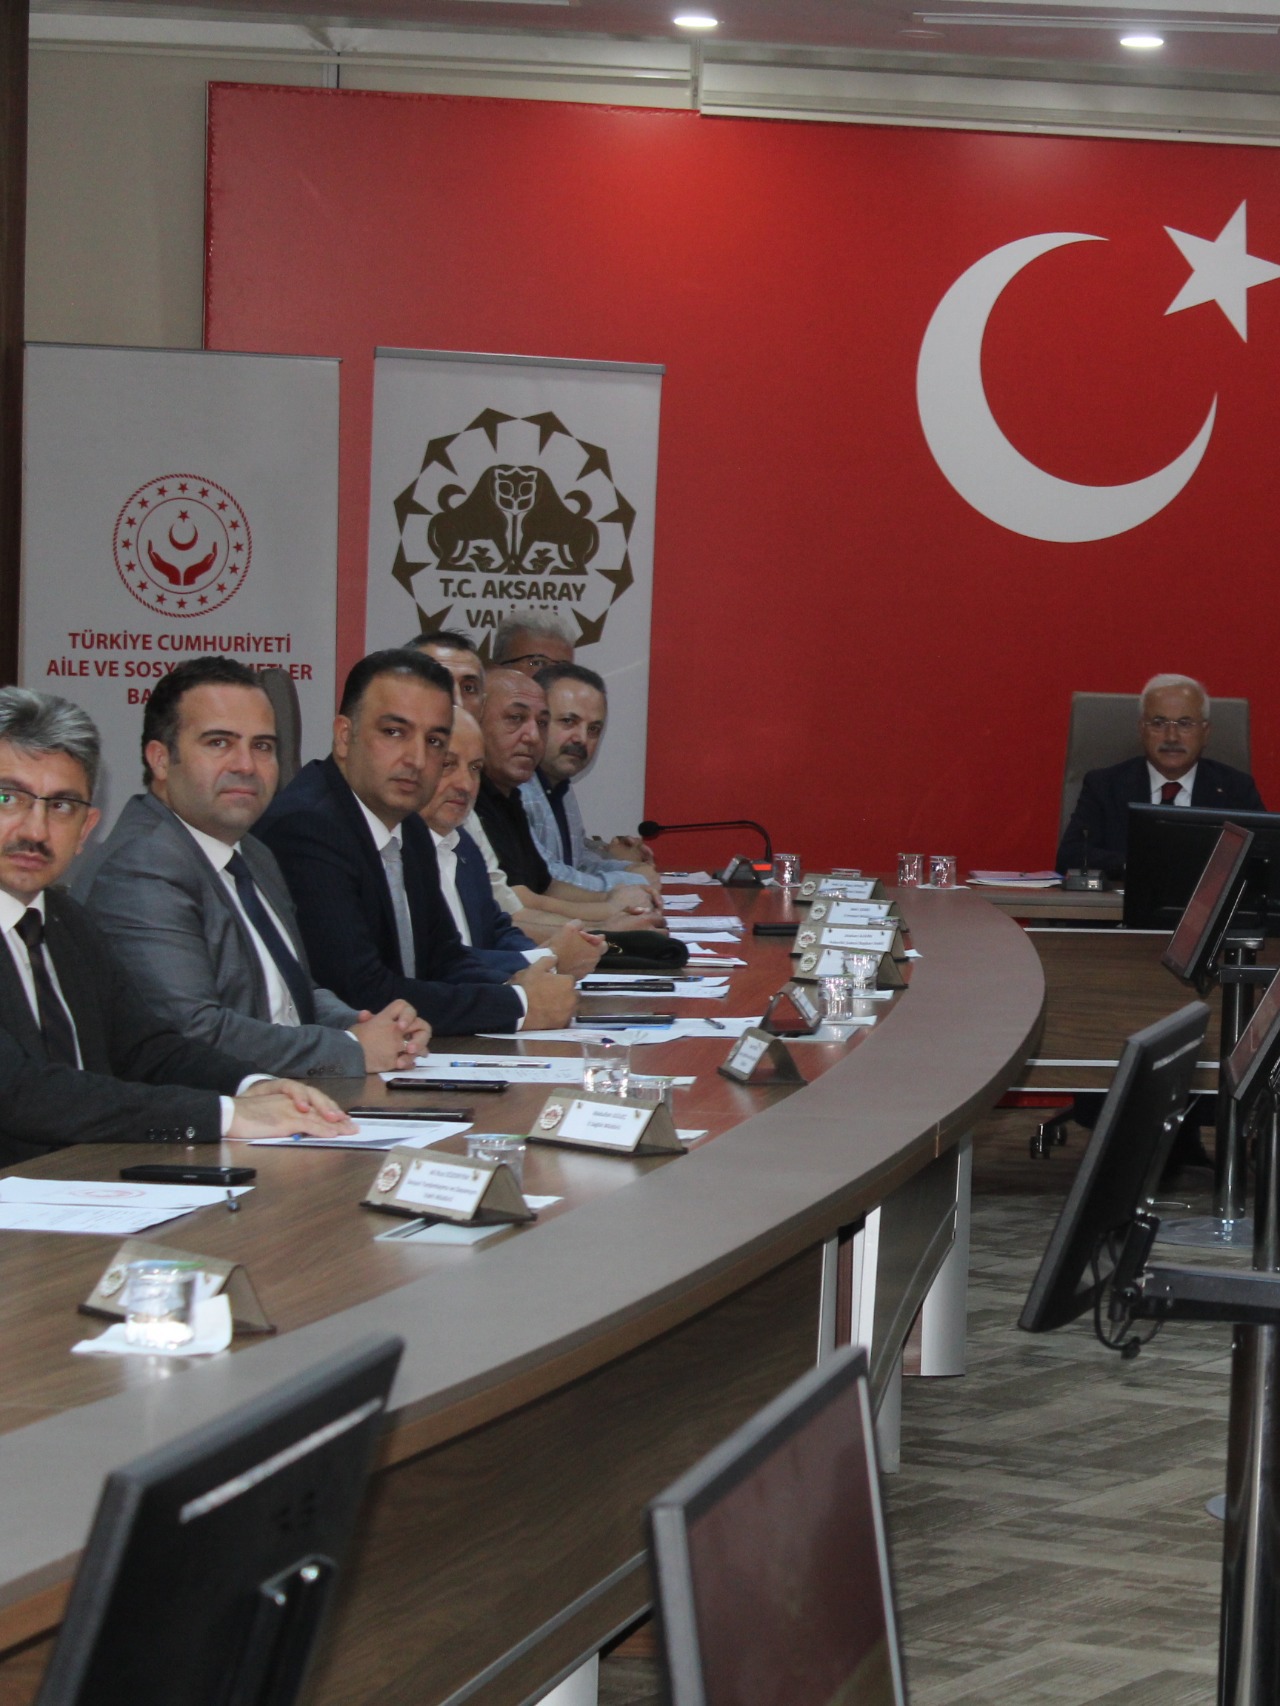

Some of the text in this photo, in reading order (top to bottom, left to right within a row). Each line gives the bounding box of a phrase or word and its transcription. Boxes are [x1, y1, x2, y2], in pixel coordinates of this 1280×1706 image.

[440, 578, 586, 601] T.C. AKSARAY
[68, 629, 291, 653] TÜRKİYE CUMHURİYETİ
[47, 656, 177, 678] AİLE VE SOSY
